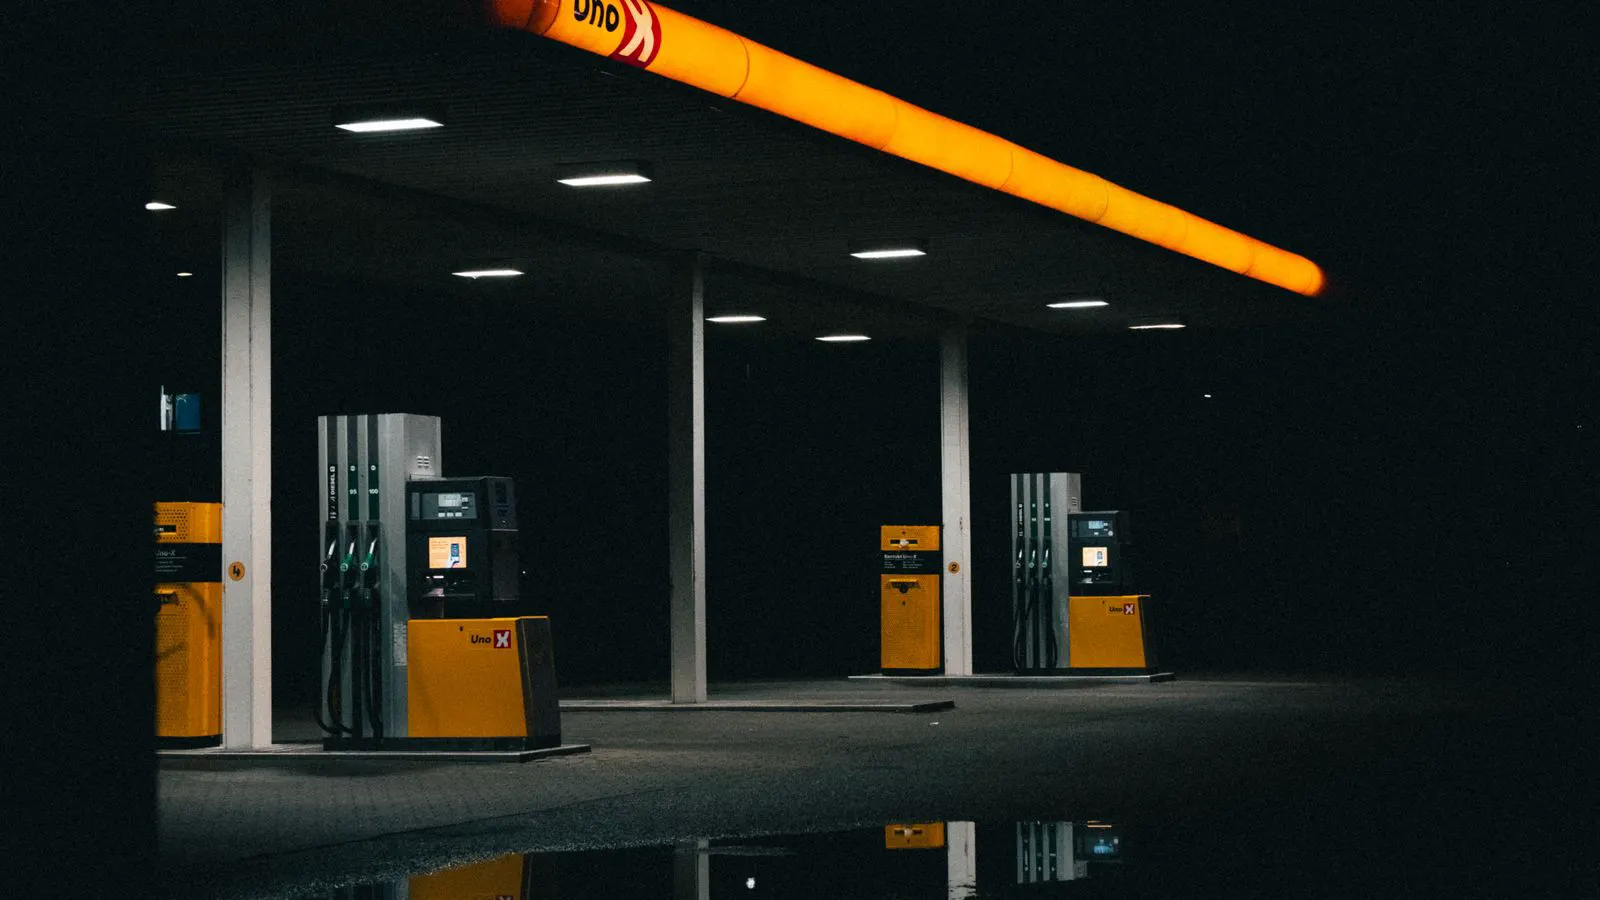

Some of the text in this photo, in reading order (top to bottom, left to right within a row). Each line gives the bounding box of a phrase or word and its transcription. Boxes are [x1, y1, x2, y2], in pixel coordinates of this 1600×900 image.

[574, 0, 655, 63] Uno X
[233, 565, 241, 577] 4
[951, 564, 957, 572] 2
[1125, 604, 1134, 614] X
[471, 631, 510, 648] Uno X
